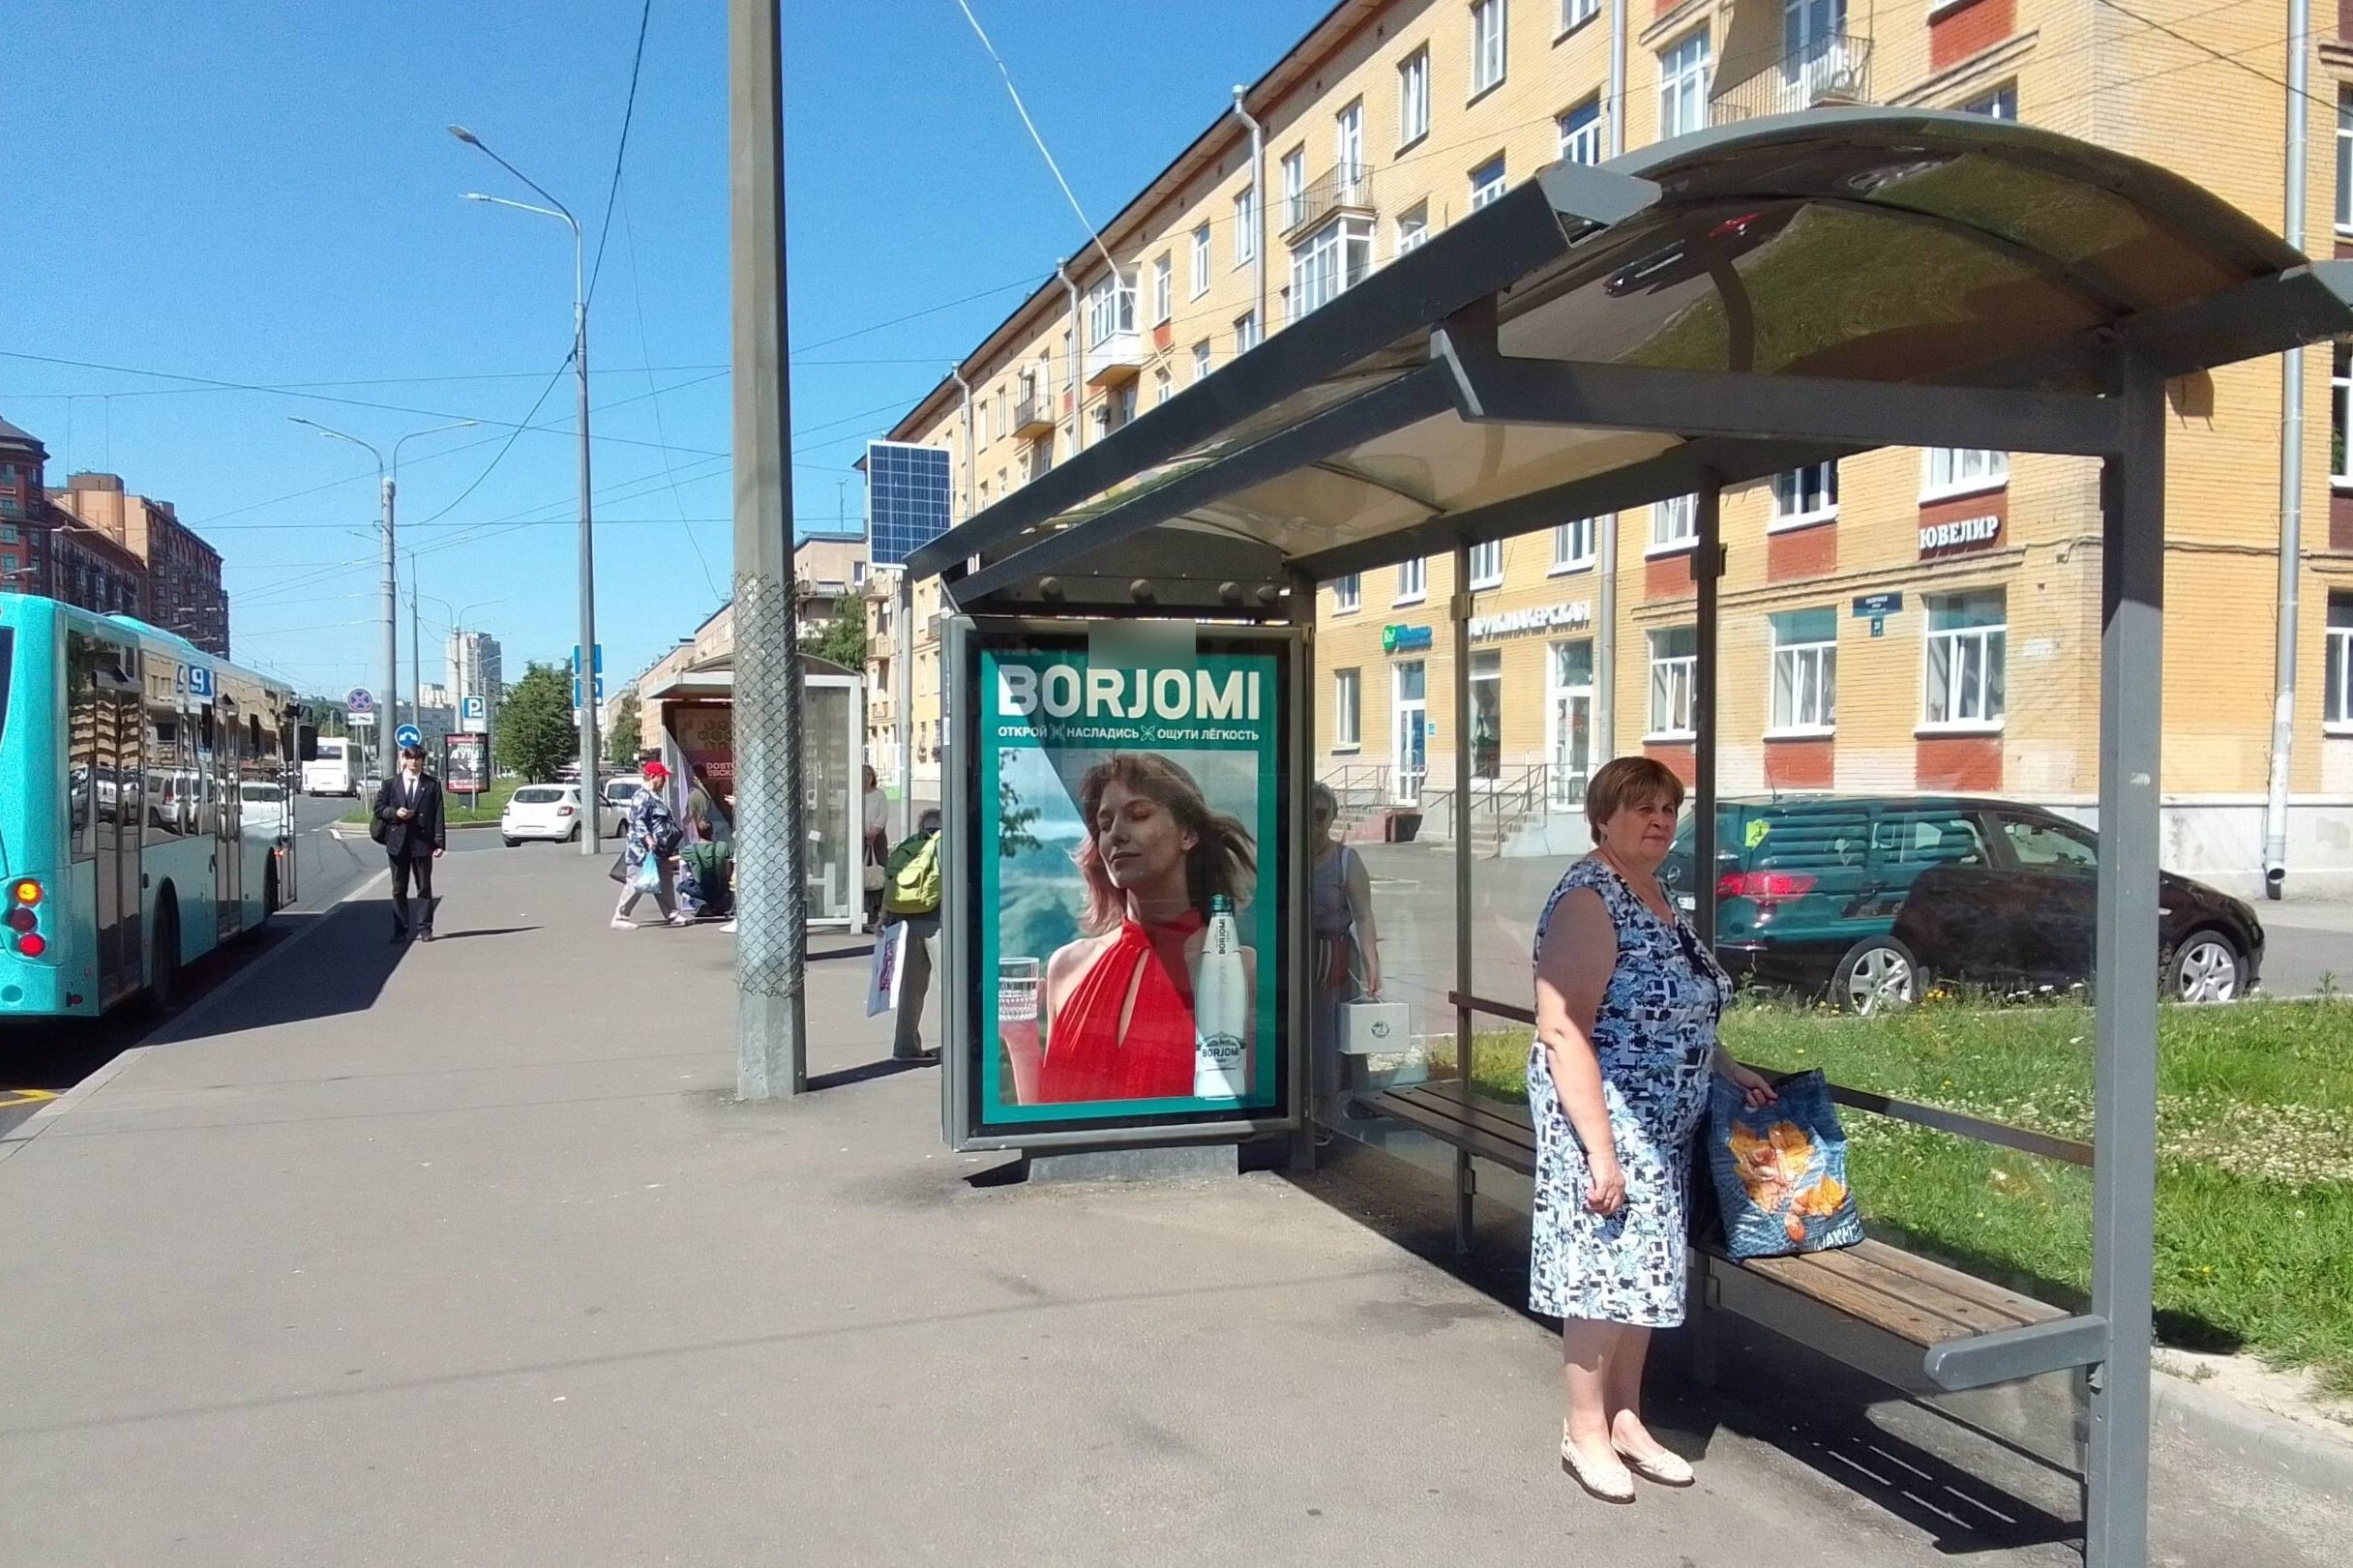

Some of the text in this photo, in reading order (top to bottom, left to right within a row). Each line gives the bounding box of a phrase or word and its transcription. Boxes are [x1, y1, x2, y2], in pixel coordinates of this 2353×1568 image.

[1920, 515, 1999, 549] ЮВЕЛИР
[998, 664, 1260, 721] BORJOMI
[998, 726, 1259, 742] ОТКРОЙ НАСЛАДИСЬ ОЩУТИ ЛЁГКОСТЬ
[1202, 1047, 1239, 1057] BORJOMI
